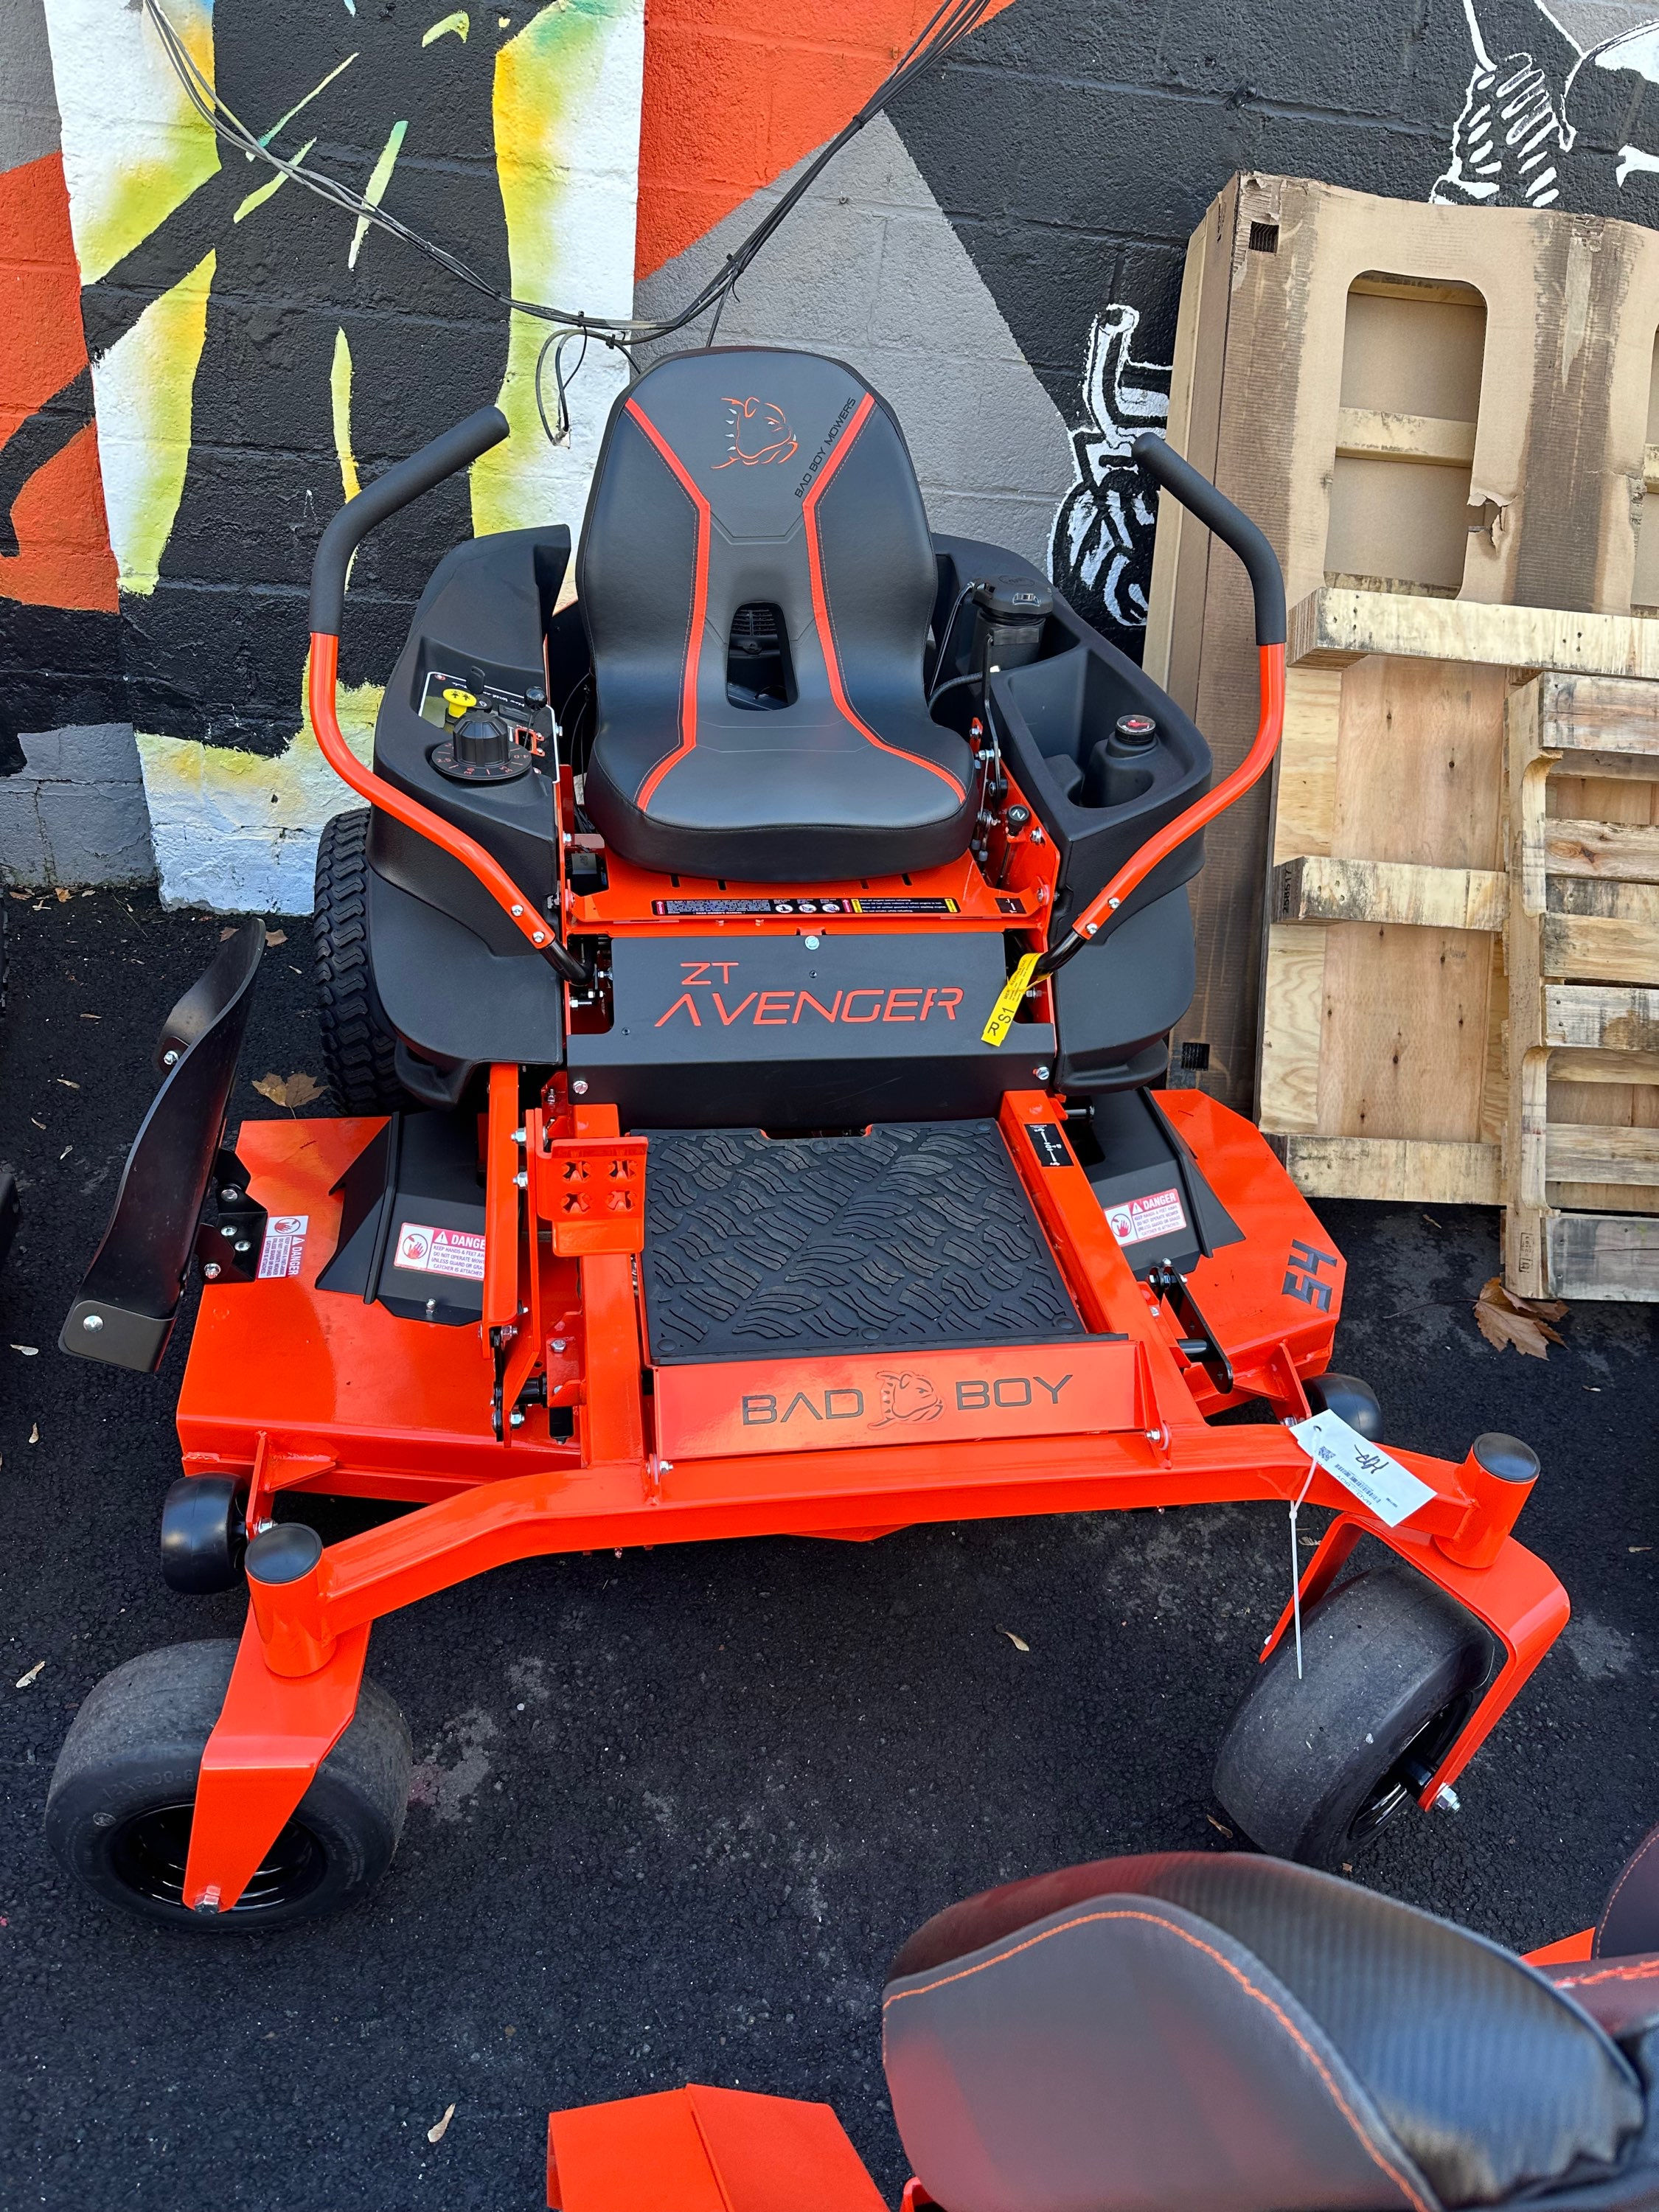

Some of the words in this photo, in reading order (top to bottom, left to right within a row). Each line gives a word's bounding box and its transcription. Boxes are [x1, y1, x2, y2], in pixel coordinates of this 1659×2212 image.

[795, 473, 812, 498] BAD
[809, 446, 826, 472] BOY
[824, 397, 856, 445] MOWERS
[681, 961, 739, 985] ZT
[654, 987, 964, 1027] AVENGER
[1143, 1192, 1176, 1211] DANGER
[451, 1234, 485, 1250] DANGE
[288, 1247, 302, 1275] DANGER
[1281, 1239, 1337, 1313] 54
[741, 1388, 865, 1425] BAD
[955, 1374, 1074, 1411] BOY
